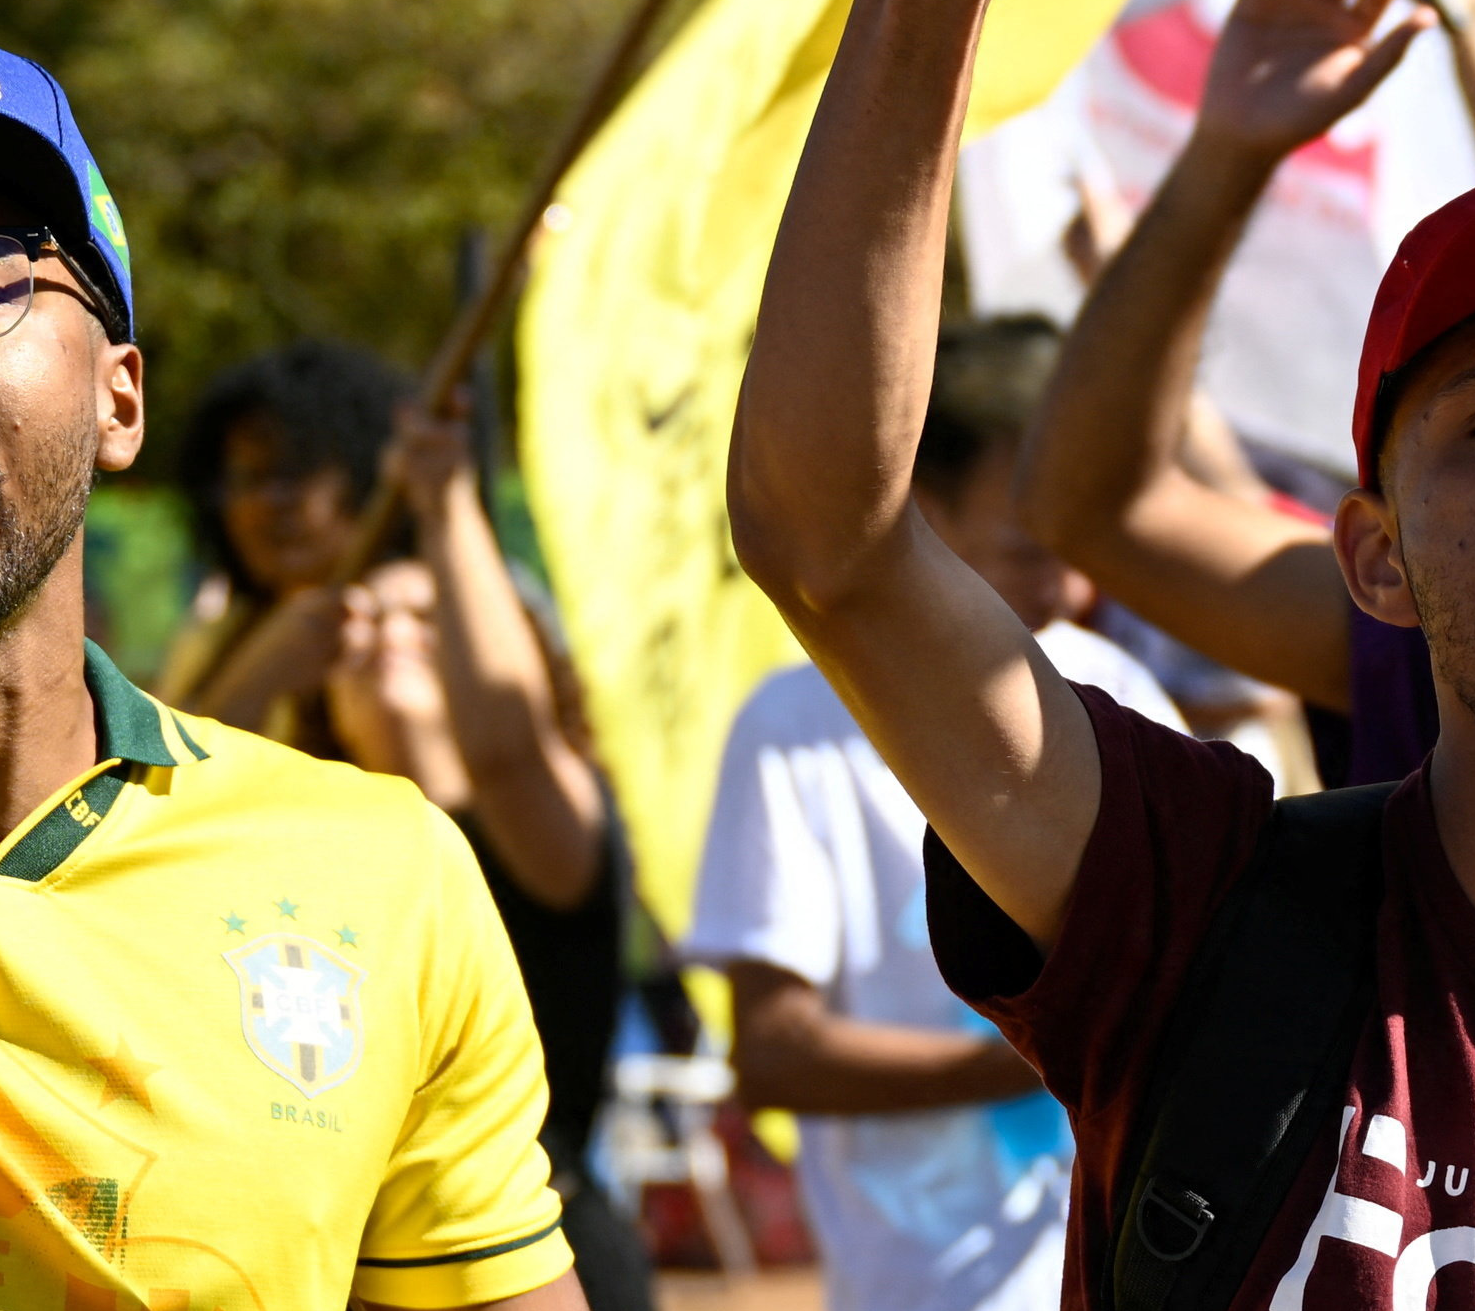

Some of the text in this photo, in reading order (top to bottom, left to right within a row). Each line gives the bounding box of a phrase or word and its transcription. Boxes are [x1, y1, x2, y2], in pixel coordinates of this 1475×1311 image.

[65, 788, 102, 829] CBF
[275, 992, 329, 1017] CBF
[269, 1101, 343, 1132] BRASIL
